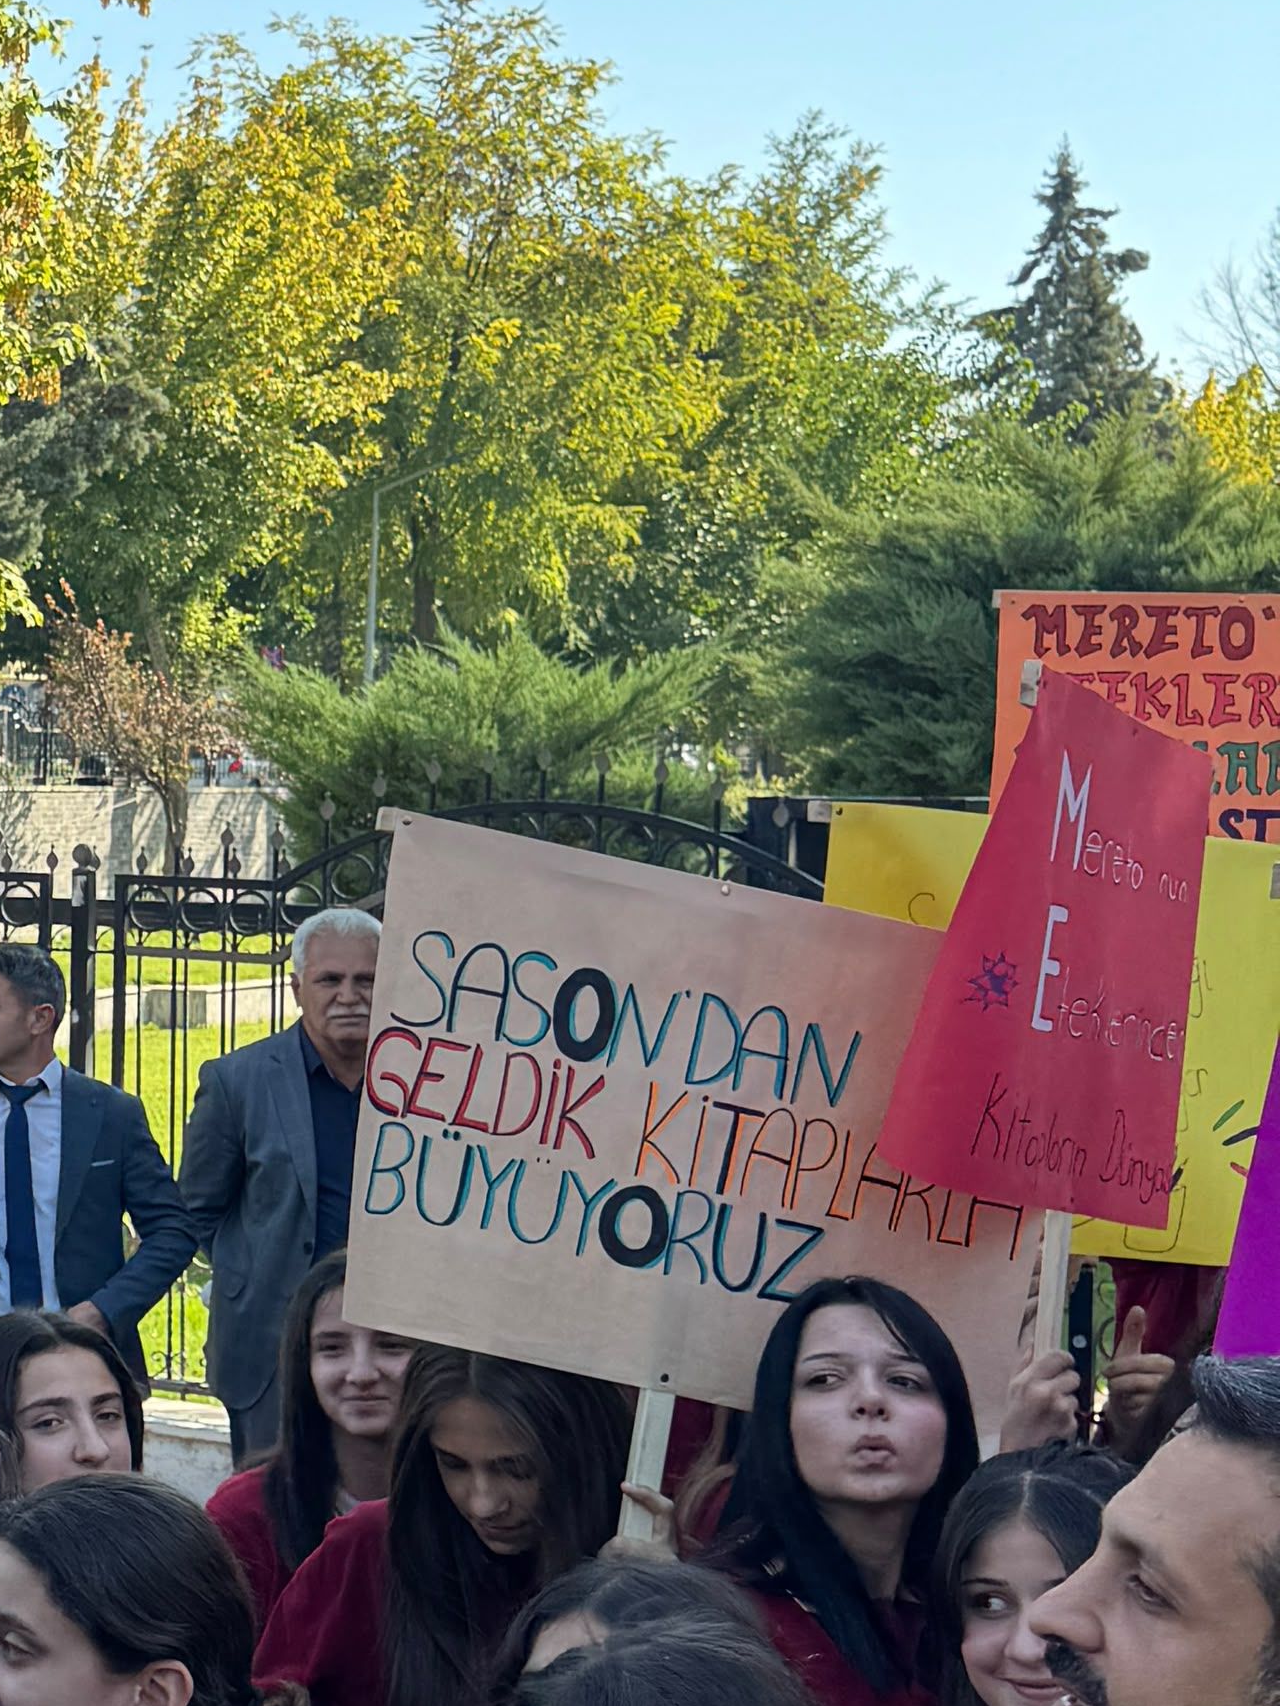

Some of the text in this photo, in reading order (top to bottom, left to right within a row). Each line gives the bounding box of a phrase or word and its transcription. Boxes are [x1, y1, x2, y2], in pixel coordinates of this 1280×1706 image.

[364, 1025, 607, 1161] GELDİK
[389, 930, 864, 1109] SASON'DAN
[363, 1121, 827, 1303] BÜYÜYORUZ
